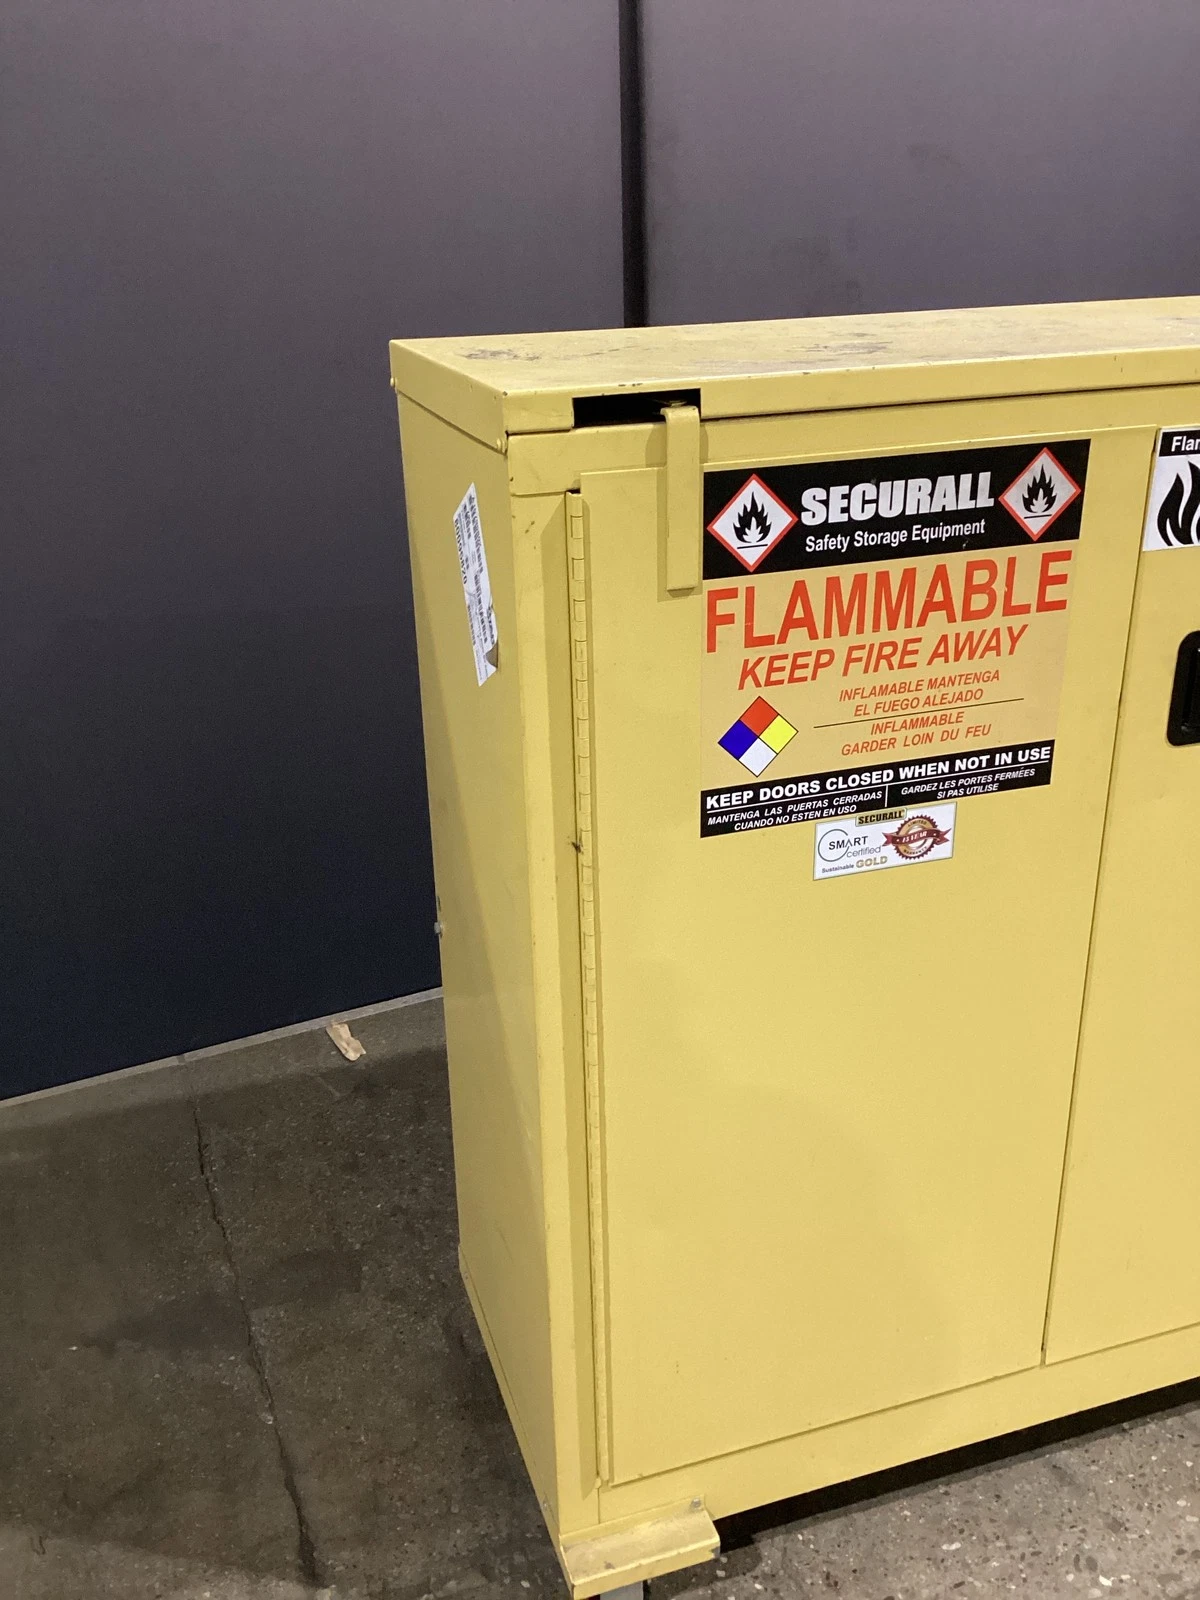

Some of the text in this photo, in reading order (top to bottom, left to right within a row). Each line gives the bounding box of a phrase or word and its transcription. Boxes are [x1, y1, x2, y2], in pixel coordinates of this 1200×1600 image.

[800, 471, 994, 526] SECURALL
[805, 518, 985, 553] Safety Storage Equipment
[706, 550, 1073, 653] FLAMMABLE
[738, 624, 1028, 690] KEEP FIRE AWAY
[839, 670, 1000, 702] INFLAMABLE MANTENGA
[854, 688, 984, 717] EL FUEGO ALEJADO
[870, 711, 964, 736] INFLAMMABLE
[841, 724, 992, 756] GARDER LOIN DU FEU
[706, 746, 1051, 809] KEEP DOORS CLOSED WHEN NOT IN USE
[901, 767, 1036, 796] GARDEZ LES PORTES FERMÉES
[937, 783, 999, 800] SI PAS UTILISE
[707, 791, 882, 826] MANTENGA LAS PUERTAS CERRADAS
[734, 804, 857, 831] CUANDO NO ESTEN EN USO
[858, 810, 903, 825] SECURALL
[828, 836, 868, 850] SMART
[846, 845, 881, 858] certified
[822, 855, 888, 874] Sustainable GOLD
